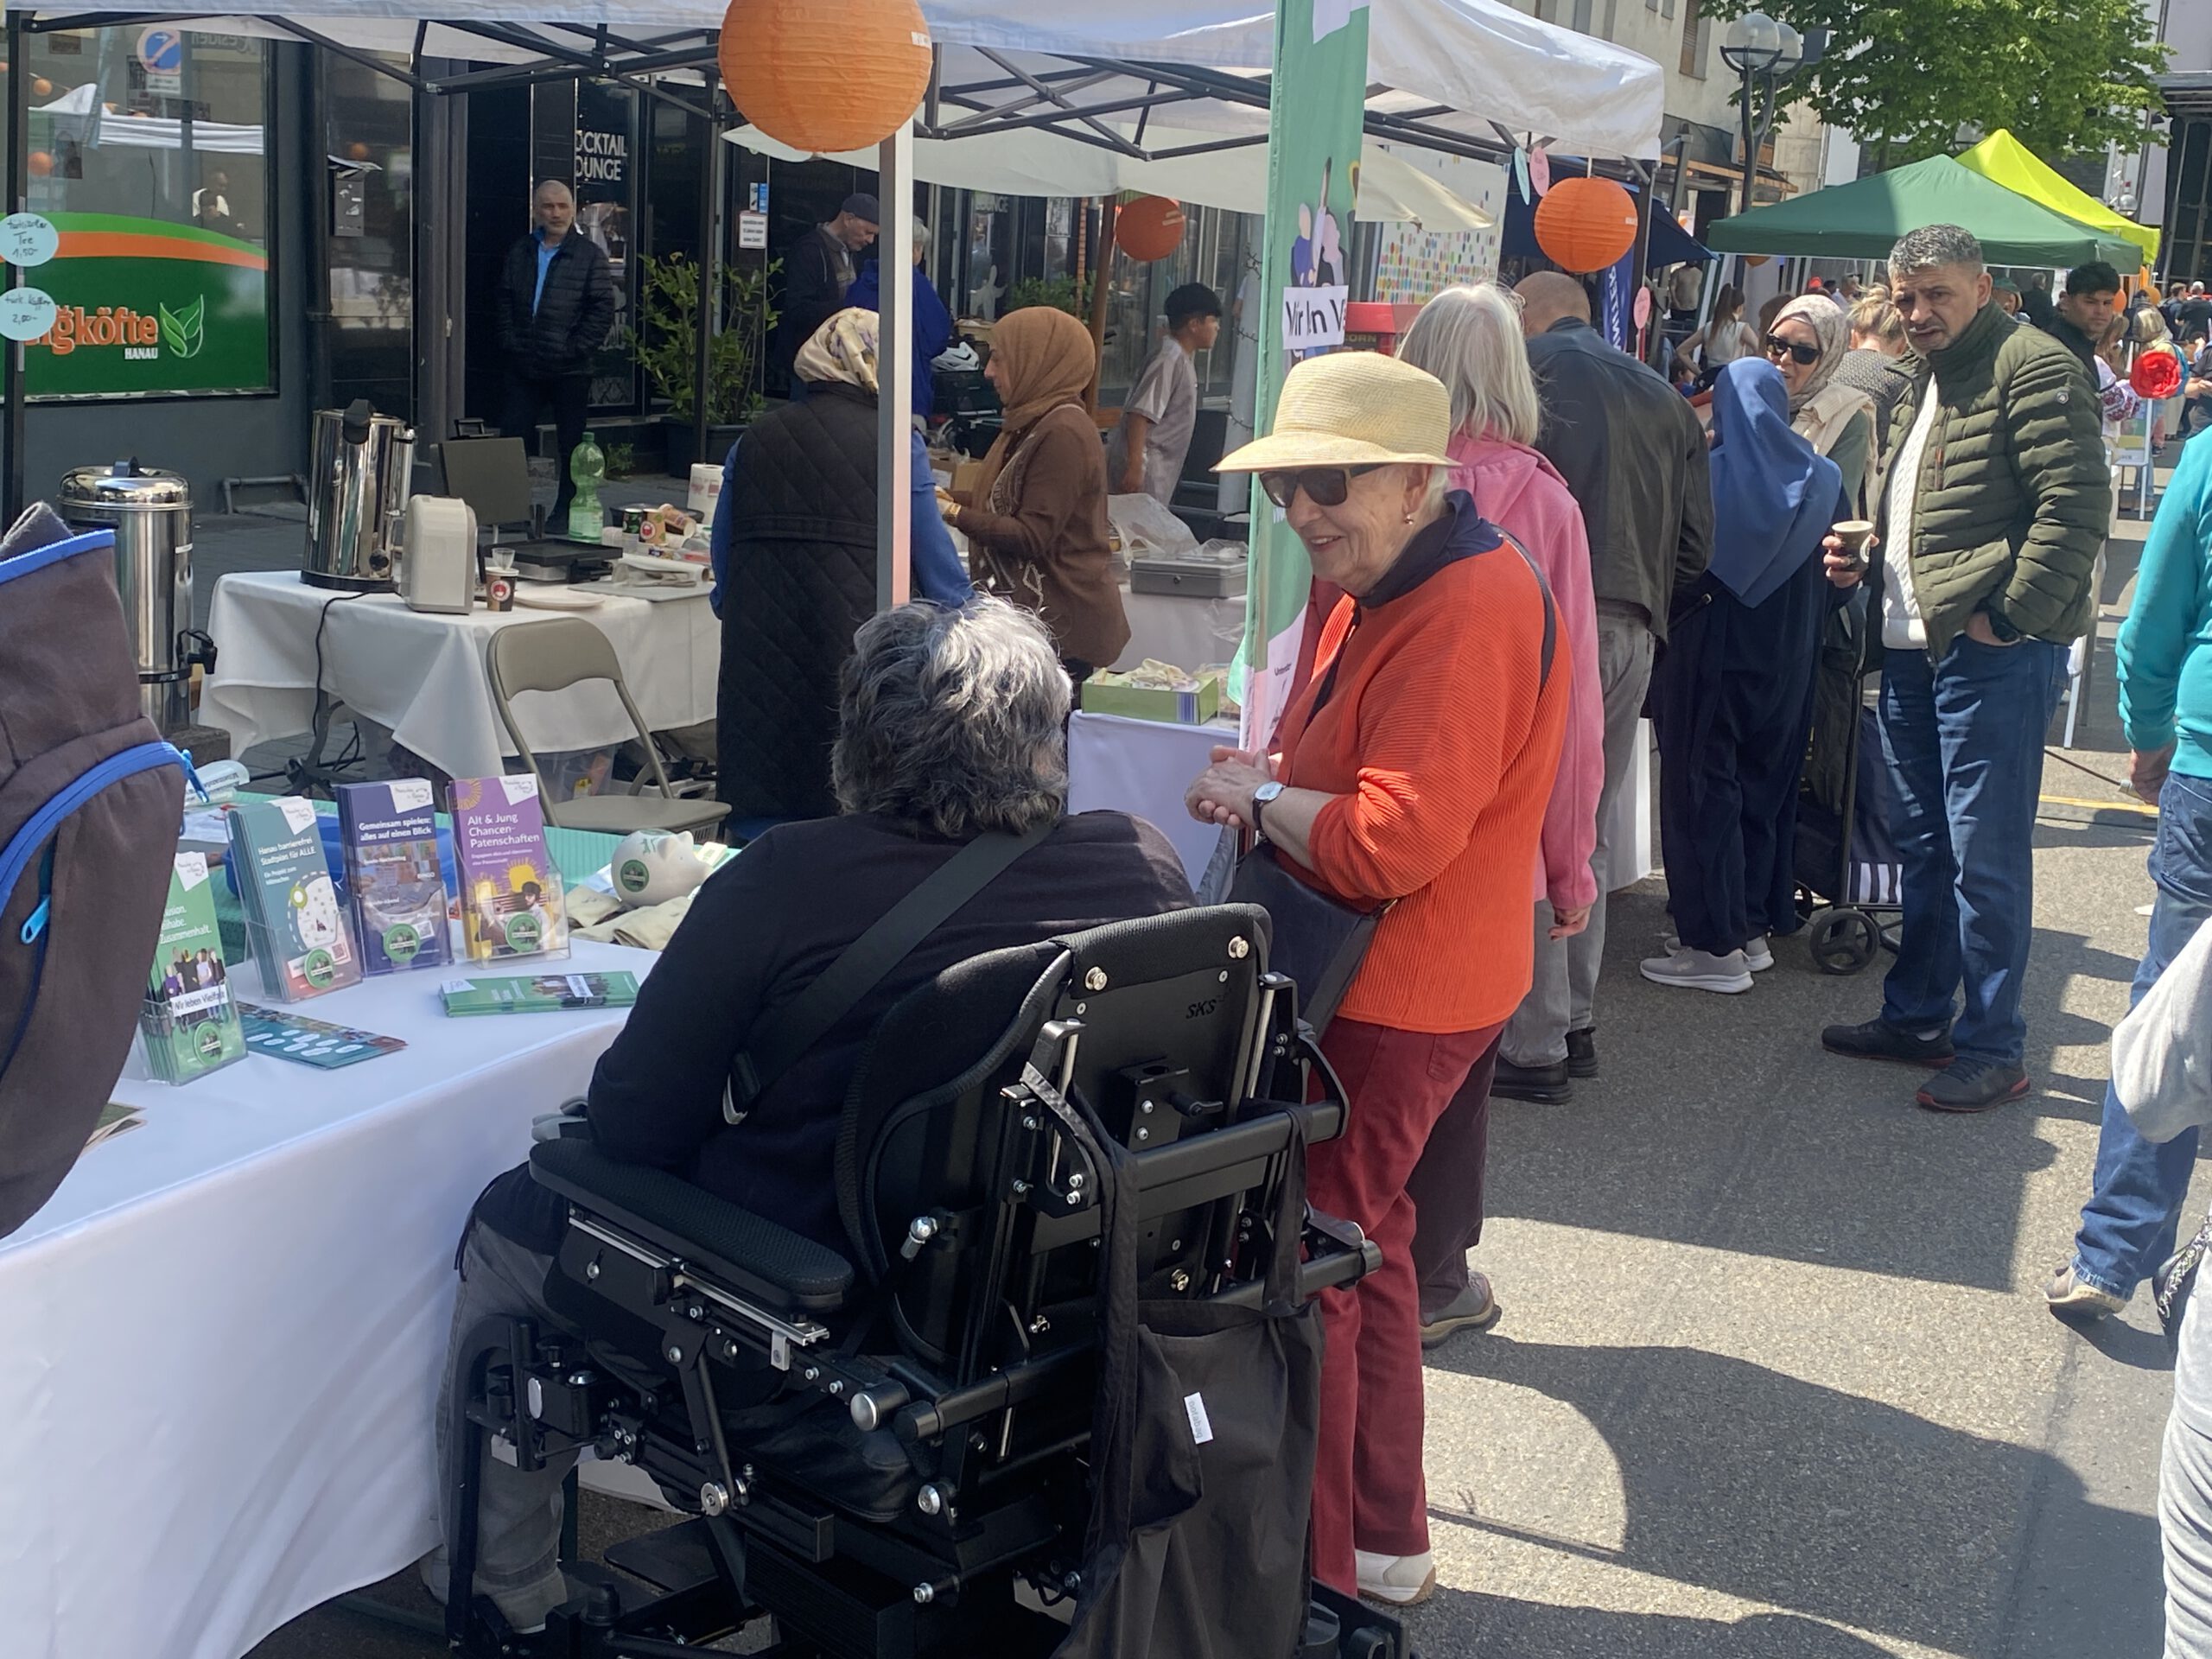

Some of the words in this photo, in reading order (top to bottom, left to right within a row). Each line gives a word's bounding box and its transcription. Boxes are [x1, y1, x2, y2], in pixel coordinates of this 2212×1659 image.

[13, 231, 35, 245] Tee
[26, 305, 158, 355] ğköfte
[124, 347, 158, 359] HANAU
[359, 821, 402, 831] Gemeinsam
[467, 815, 482, 826] Alt
[485, 814, 493, 824] &
[496, 814, 518, 824] Jung
[468, 826, 516, 837] Chancen-
[470, 834, 540, 849] Patenschaften
[299, 846, 316, 857] ALLE
[1185, 999, 1217, 1019] SKS
